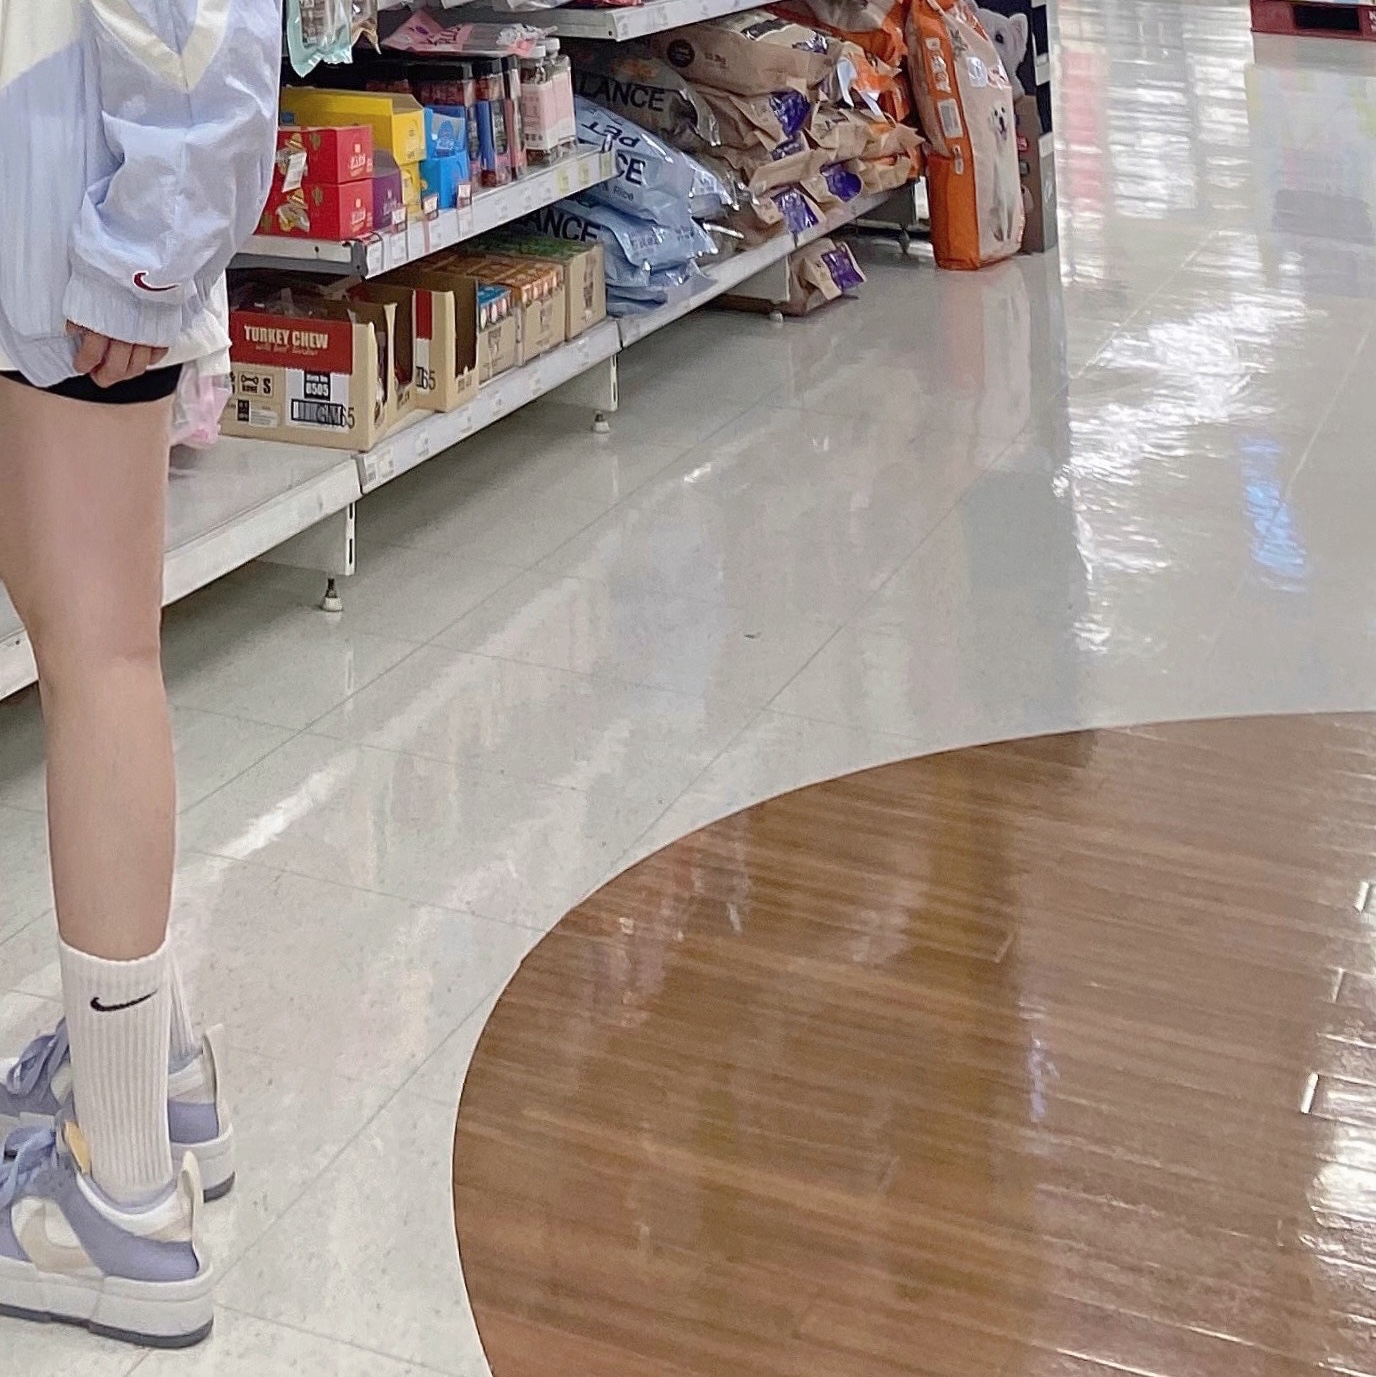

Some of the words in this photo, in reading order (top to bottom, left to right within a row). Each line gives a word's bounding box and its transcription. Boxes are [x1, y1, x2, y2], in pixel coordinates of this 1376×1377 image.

[243, 325, 291, 346] TURKEY
[291, 331, 329, 349] CHEW
[262, 377, 272, 395] S
